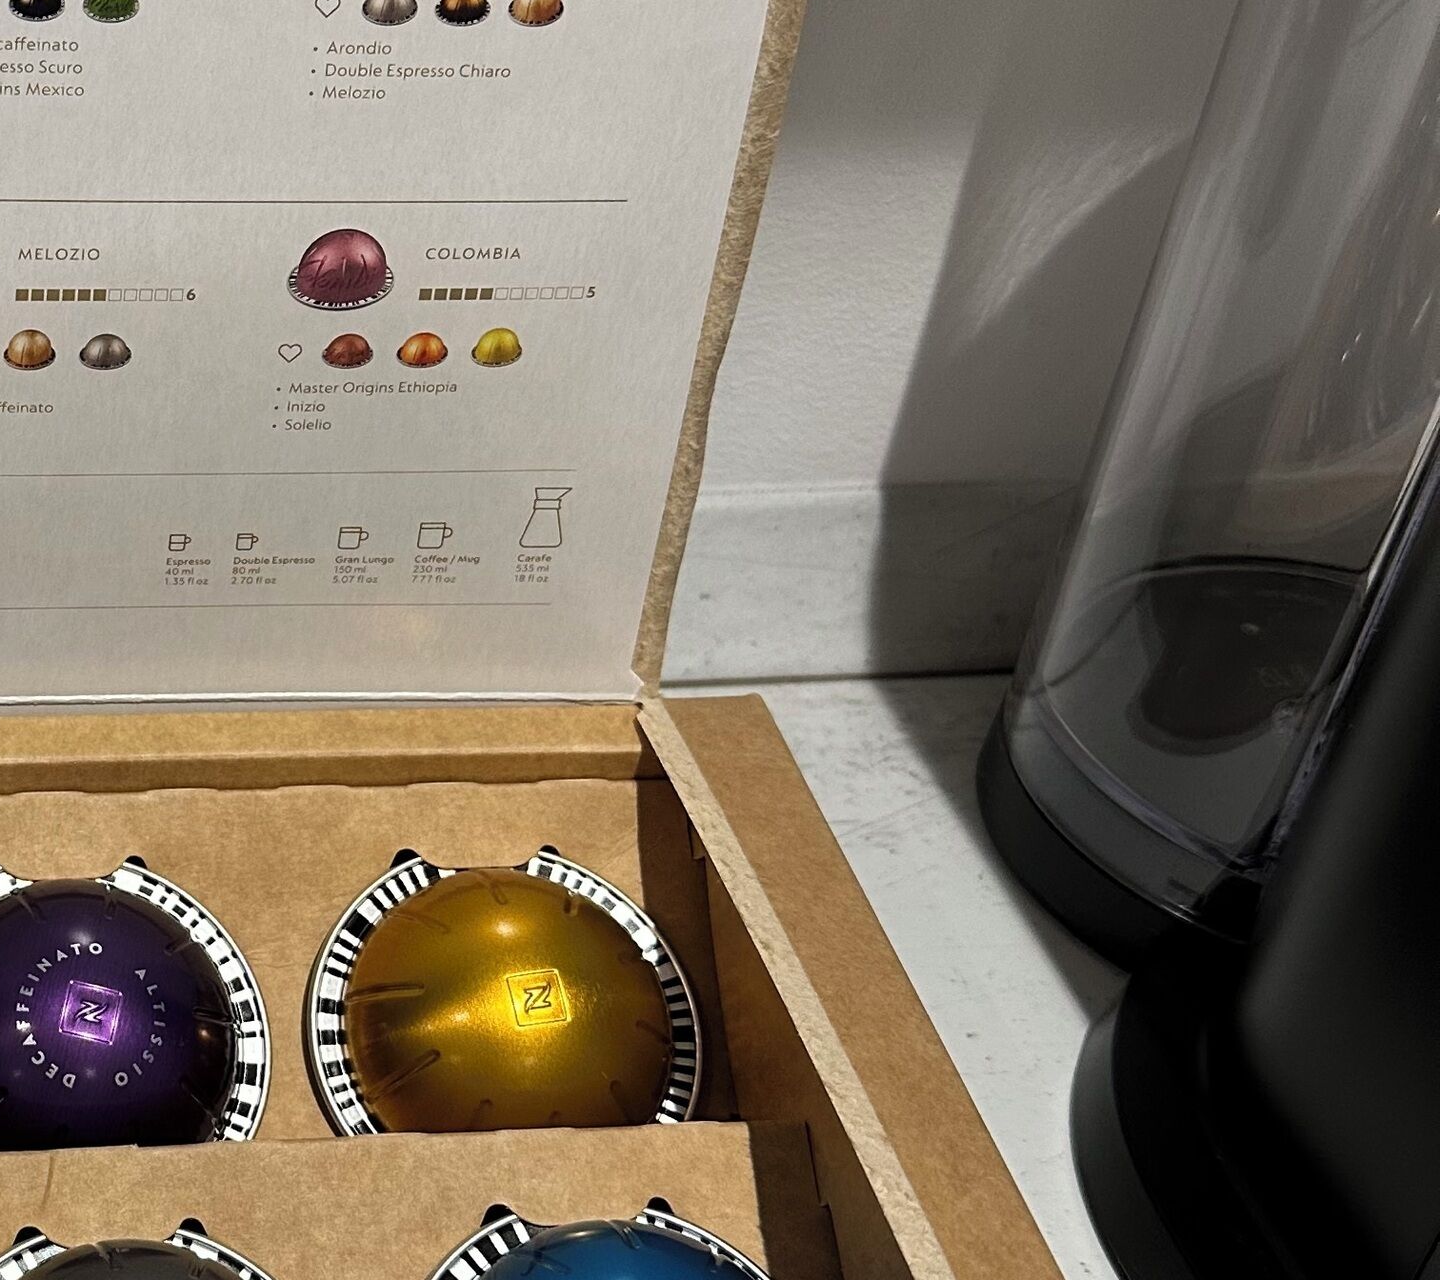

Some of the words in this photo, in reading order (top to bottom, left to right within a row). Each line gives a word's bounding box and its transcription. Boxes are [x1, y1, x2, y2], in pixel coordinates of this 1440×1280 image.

[326, 42, 392, 56] Arondio
[38, 61, 83, 75] Scuro
[324, 64, 383, 78] Double
[386, 64, 455, 81] Espresso
[459, 64, 511, 78] Chiaro
[26, 83, 85, 98] Mexico
[322, 86, 386, 100] Melozio
[18, 248, 100, 261] MELOZIO
[425, 247, 522, 260] COLOMBIA
[186, 288, 196, 301] 6
[586, 287, 596, 299] 5
[289, 382, 339, 394] Master
[343, 381, 394, 397] Origins
[398, 381, 457, 395] Ethiopia
[287, 401, 325, 413] Inizio
[285, 419, 332, 431] Solelio
[16, 942, 103, 1088] DECAFFEINATO
[115, 967, 166, 1087] ALTISSIO
